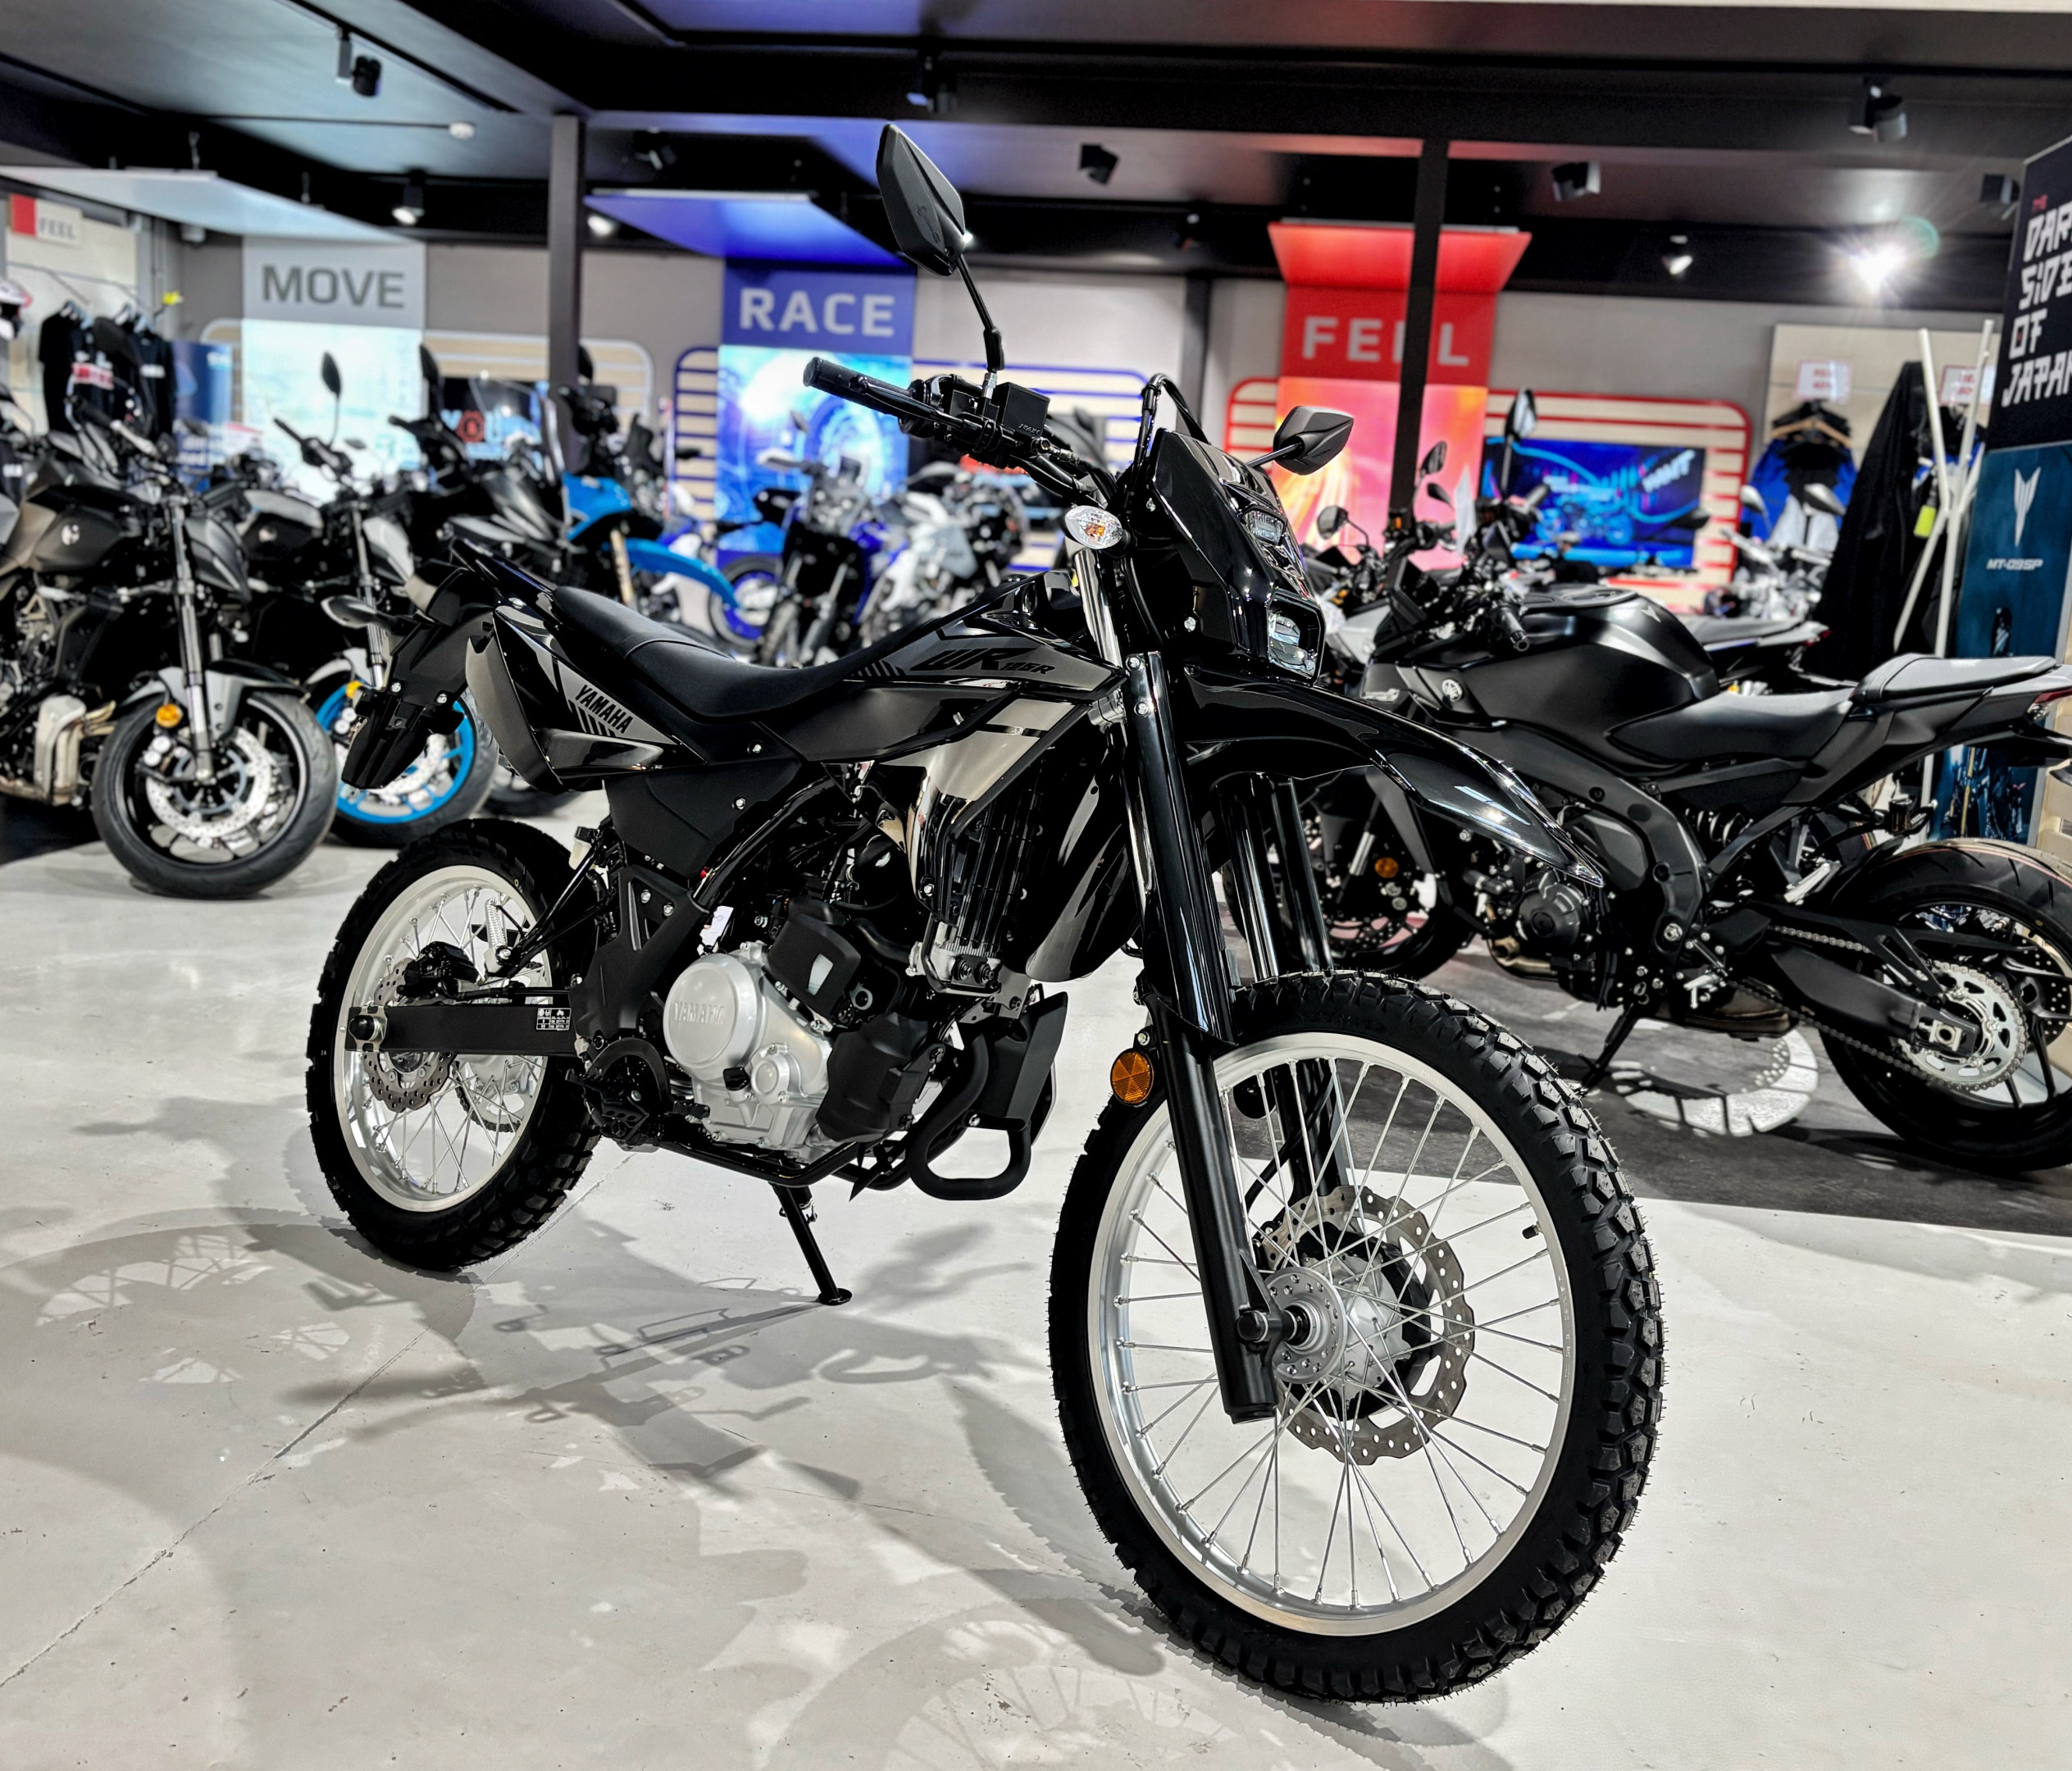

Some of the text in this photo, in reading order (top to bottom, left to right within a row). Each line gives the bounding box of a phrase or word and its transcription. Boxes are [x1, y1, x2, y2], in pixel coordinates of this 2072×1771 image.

[2023, 200, 2072, 262] DAR
[262, 264, 405, 309] MOVE
[740, 287, 895, 338] RACE
[2009, 307, 2048, 360] OF
[1986, 558, 2044, 571] MT-09SP
[575, 684, 634, 735] YAMAHA
[674, 1000, 726, 1025] YAMAHA
